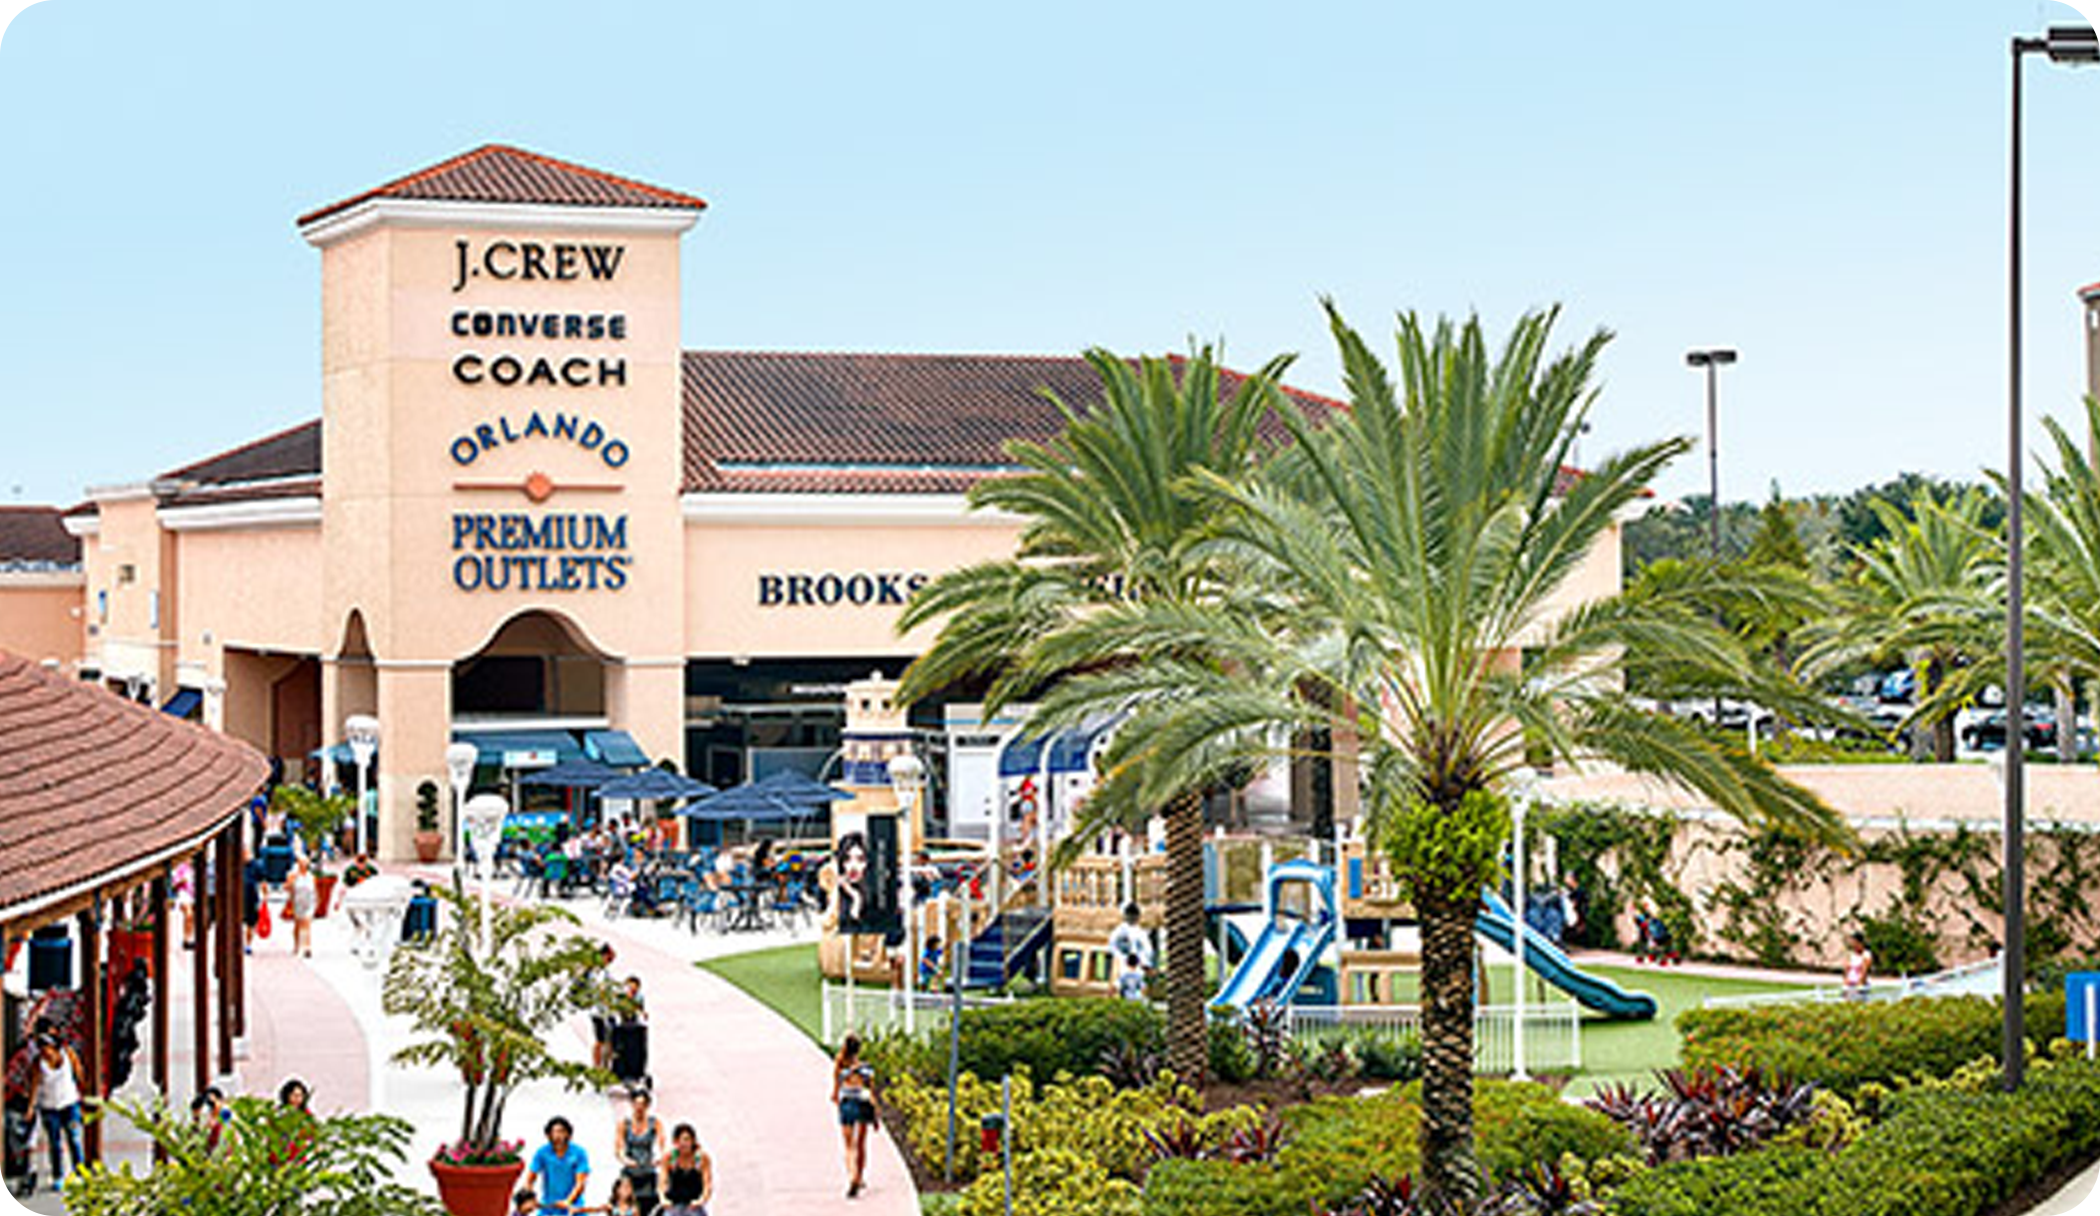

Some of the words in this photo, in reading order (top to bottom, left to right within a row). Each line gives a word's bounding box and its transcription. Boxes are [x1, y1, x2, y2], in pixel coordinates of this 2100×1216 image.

[452, 240, 625, 292] J.CREW
[451, 312, 627, 339] CONVERSE
[453, 355, 627, 386] COACH
[450, 411, 629, 468] ORLANDO
[452, 514, 628, 550] PREMIUM
